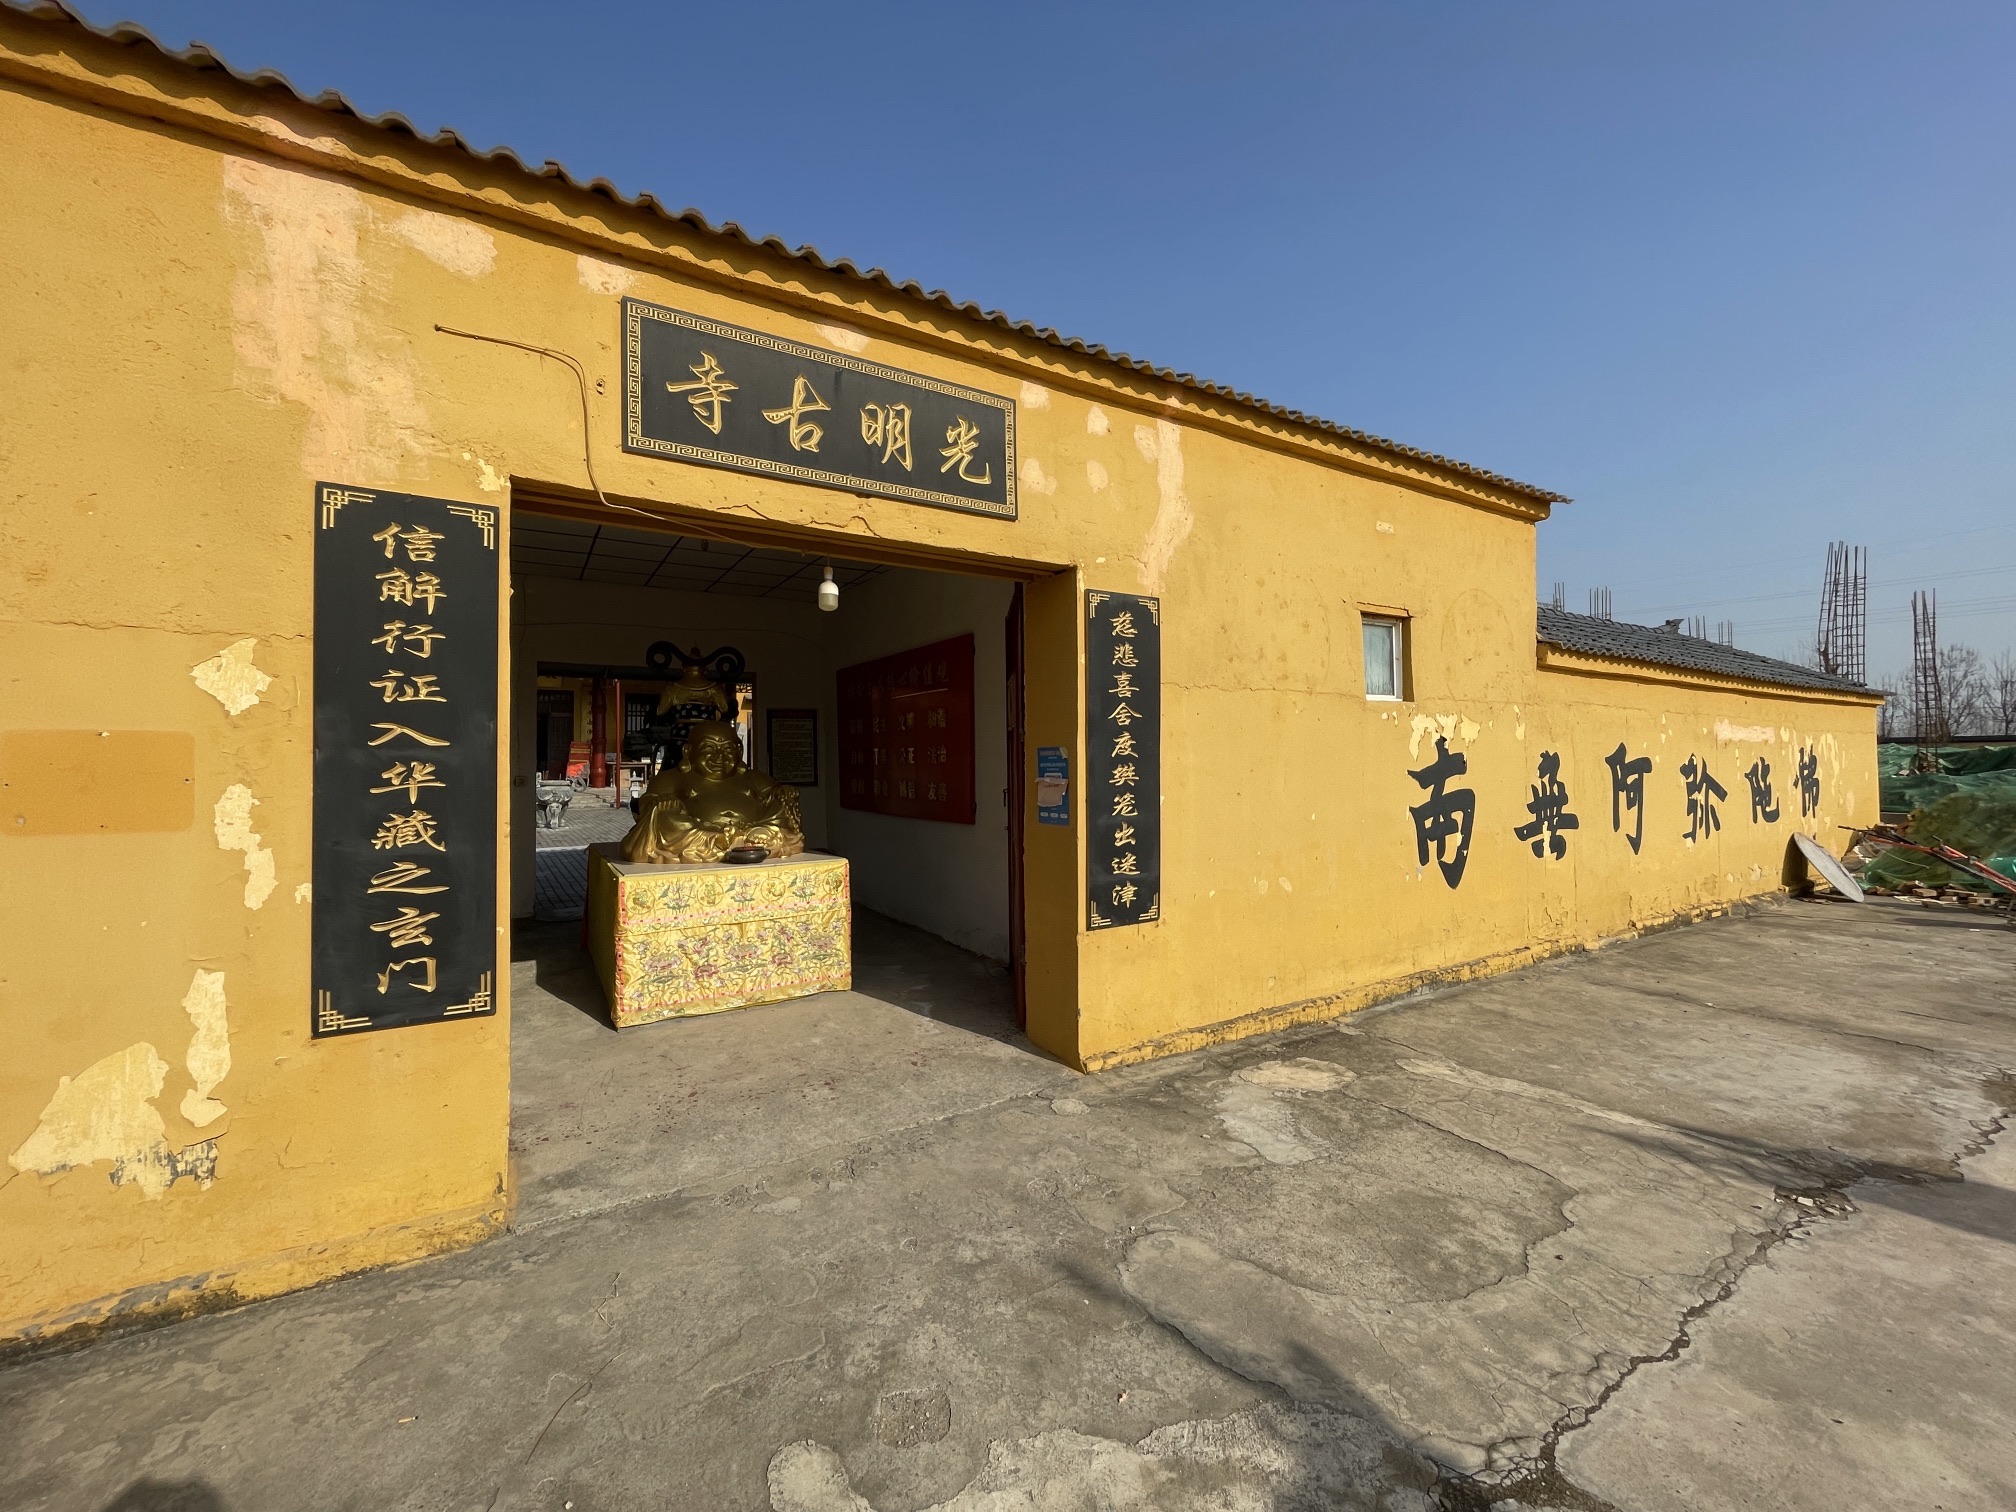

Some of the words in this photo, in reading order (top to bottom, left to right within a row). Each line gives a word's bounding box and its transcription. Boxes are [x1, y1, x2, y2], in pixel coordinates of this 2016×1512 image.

[666, 351, 992, 485] 光明古寺
[367, 522, 450, 994] 信解行证入华藏之玄门
